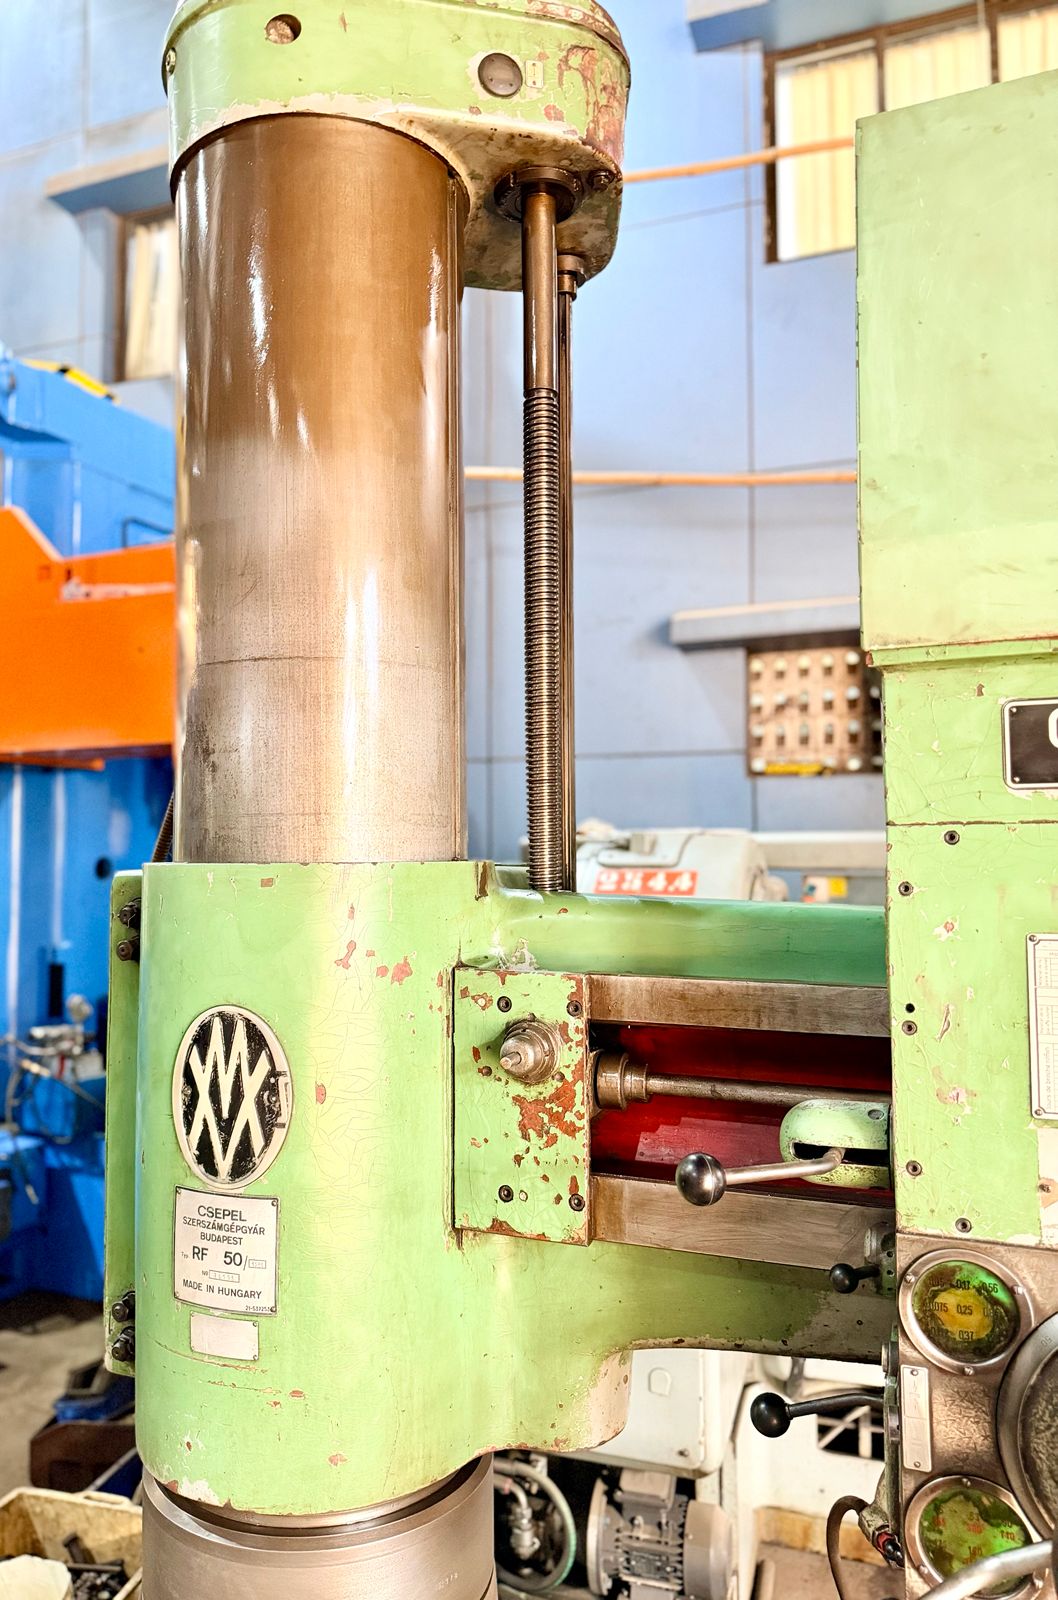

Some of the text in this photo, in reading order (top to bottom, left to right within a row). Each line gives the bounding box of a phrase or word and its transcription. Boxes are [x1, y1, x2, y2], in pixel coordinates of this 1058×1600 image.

[197, 1205, 247, 1222] CSEPEL
[182, 1216, 266, 1236] SZERSZÁMGÉPGYÁR
[200, 1232, 243, 1246] BUDAPEST
[192, 1246, 208, 1261] RF
[182, 1279, 262, 1300] MADE IN HUNGARY
